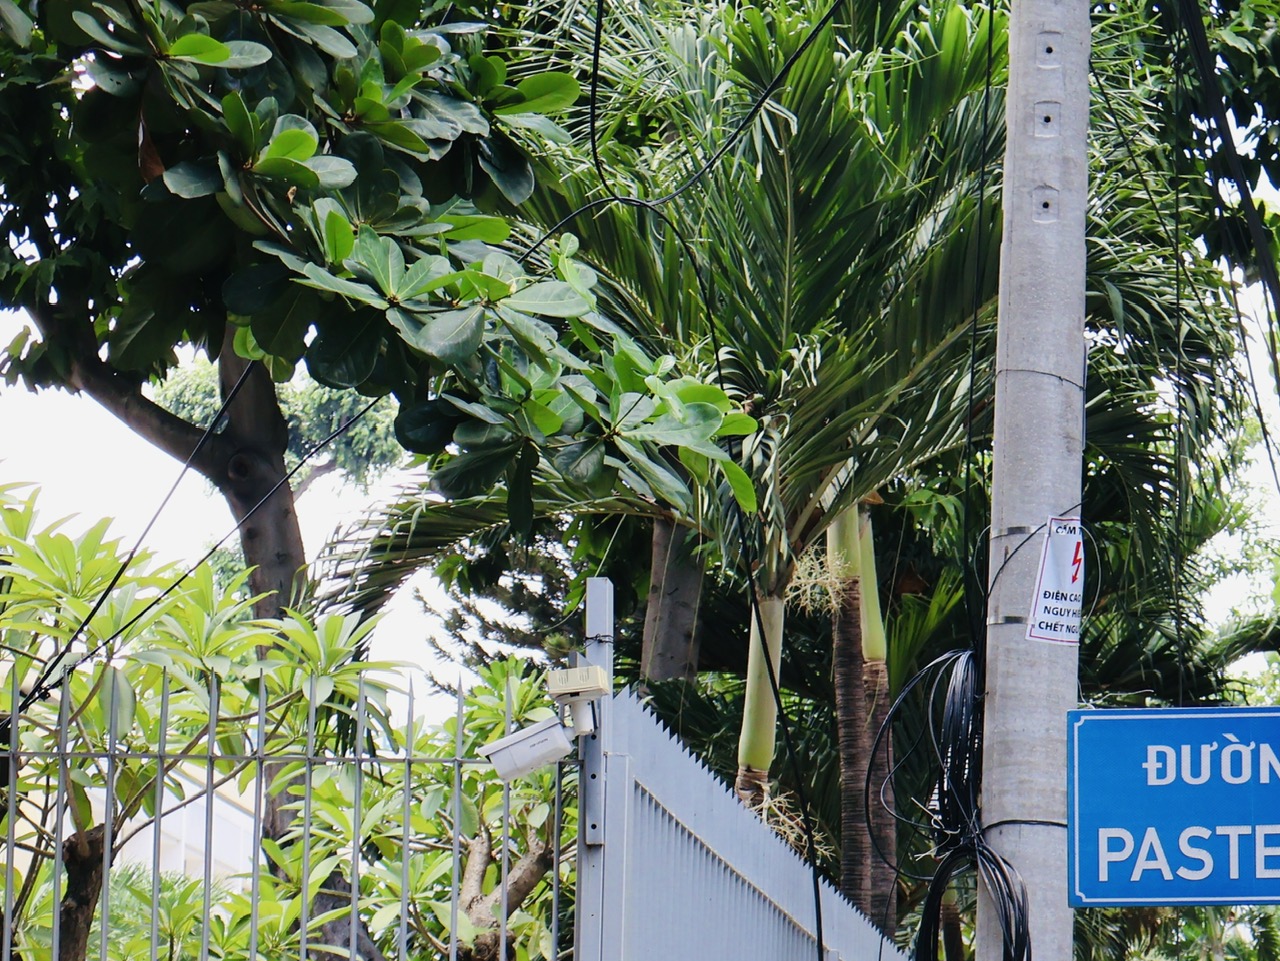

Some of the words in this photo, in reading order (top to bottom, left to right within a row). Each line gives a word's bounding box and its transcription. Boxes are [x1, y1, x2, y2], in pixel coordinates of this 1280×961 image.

[1043, 590, 1068, 603] ĐIỆN
[1043, 605, 1071, 617] NGUY
[1038, 620, 1065, 632] CHẾT
